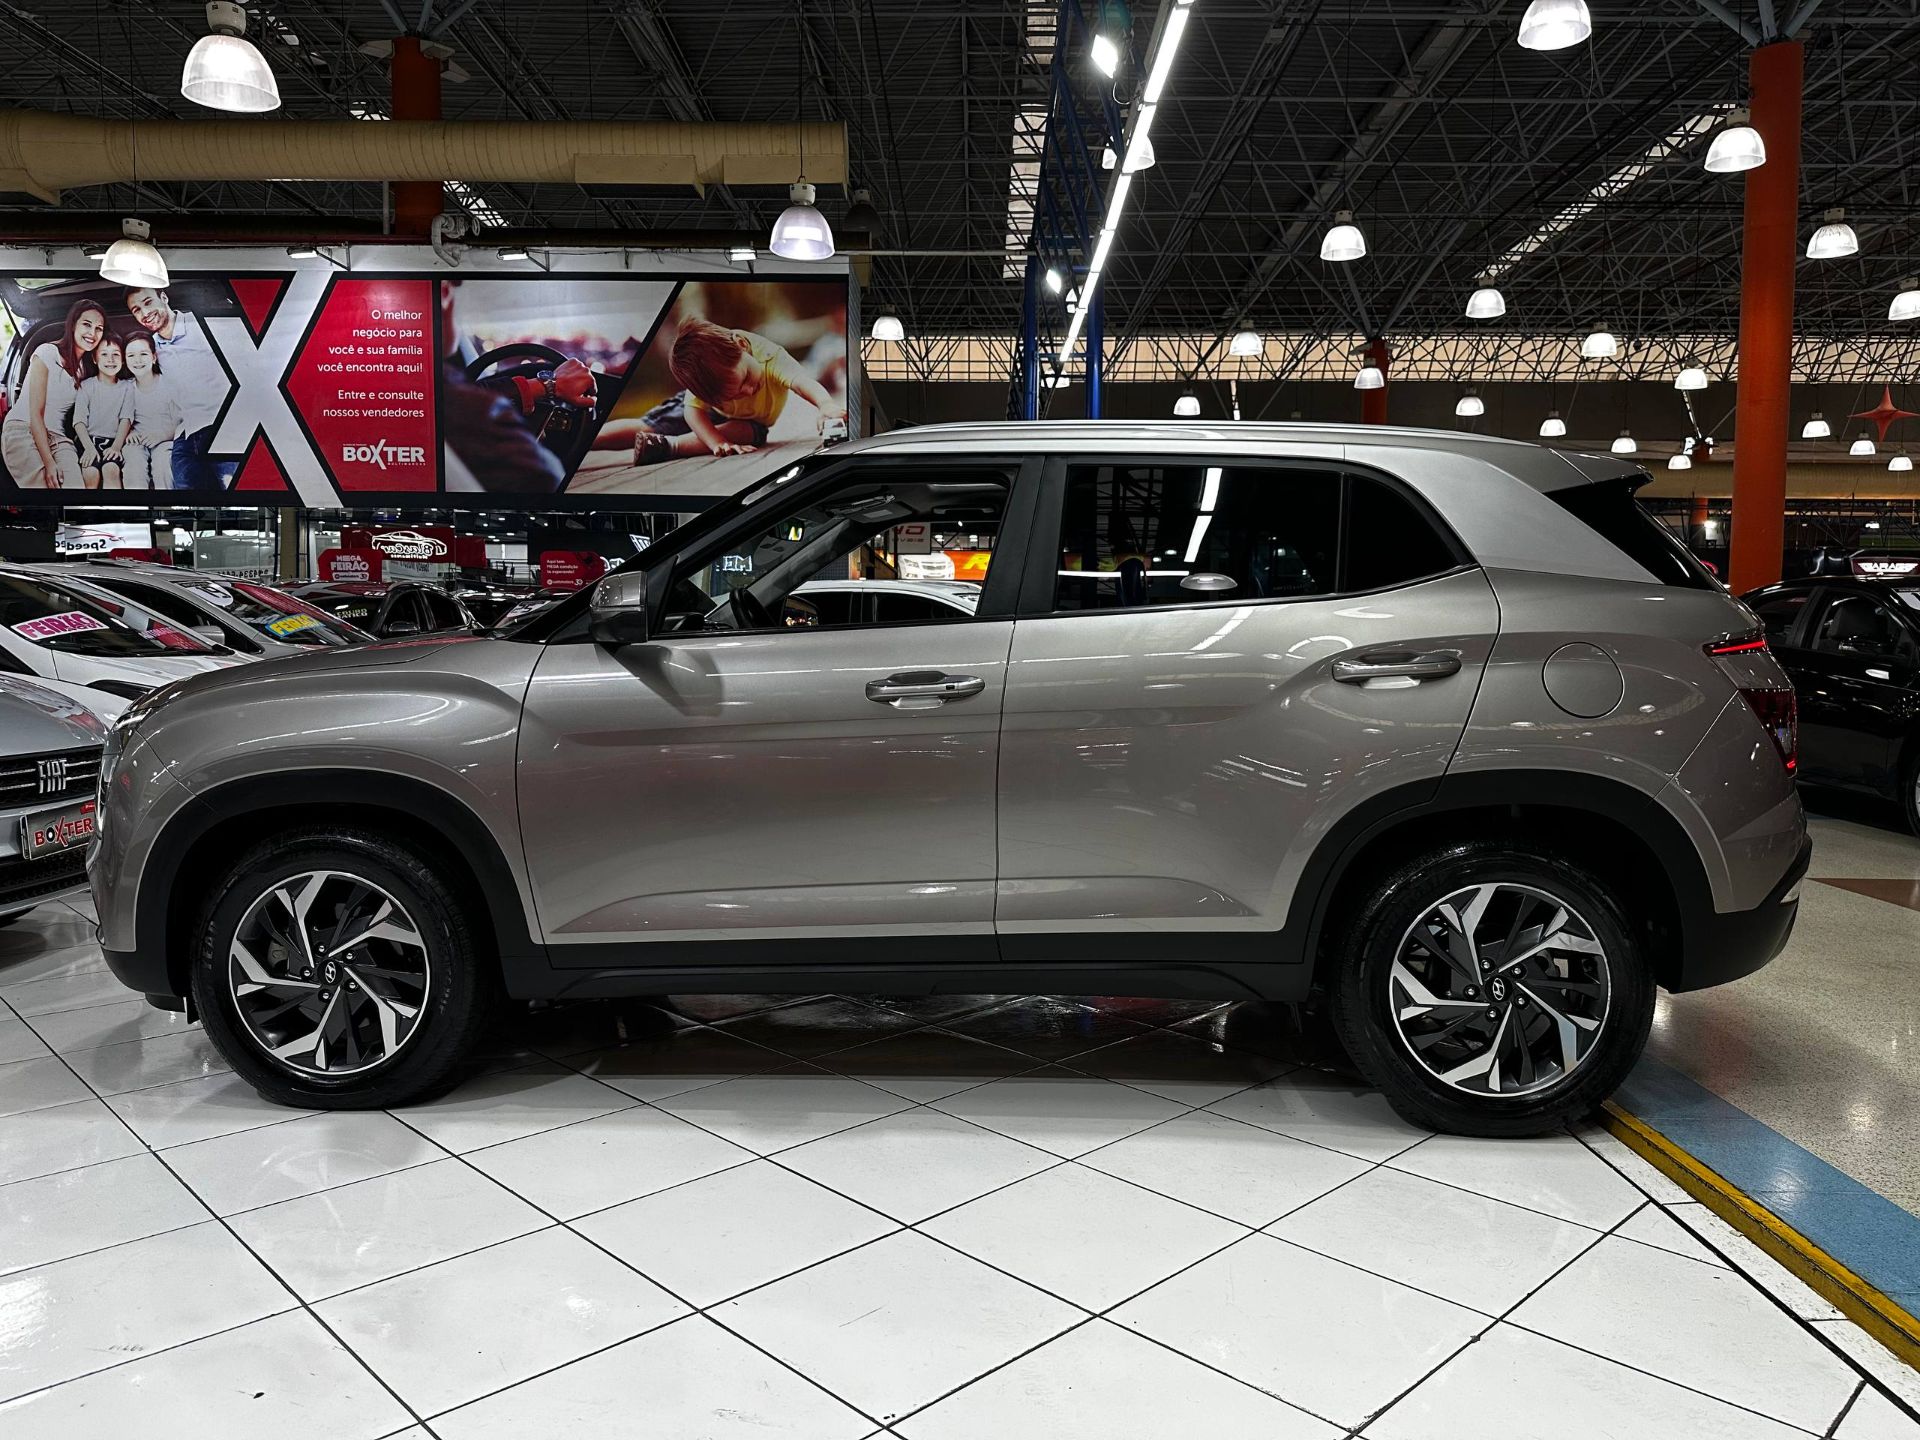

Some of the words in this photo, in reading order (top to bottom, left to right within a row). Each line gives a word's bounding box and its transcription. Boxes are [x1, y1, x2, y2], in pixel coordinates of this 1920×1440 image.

[371, 310, 381, 320] O
[384, 309, 422, 320] melhor
[352, 328, 396, 339] negócio
[399, 329, 423, 339] para
[328, 344, 355, 355] você
[357, 347, 363, 355] e
[366, 347, 385, 355] sua
[387, 345, 423, 355] família
[317, 362, 343, 372] você
[346, 364, 394, 372] encontra
[396, 363, 423, 374] aqui!
[338, 390, 367, 400] Entre
[368, 392, 375, 400] e
[378, 390, 424, 400] consulte
[323, 409, 360, 417] nossos
[362, 407, 425, 418] vendedores
[342, 438, 426, 470] BOXTER
[37, 758, 67, 794] FIAT
[34, 816, 94, 847] BOXTER
